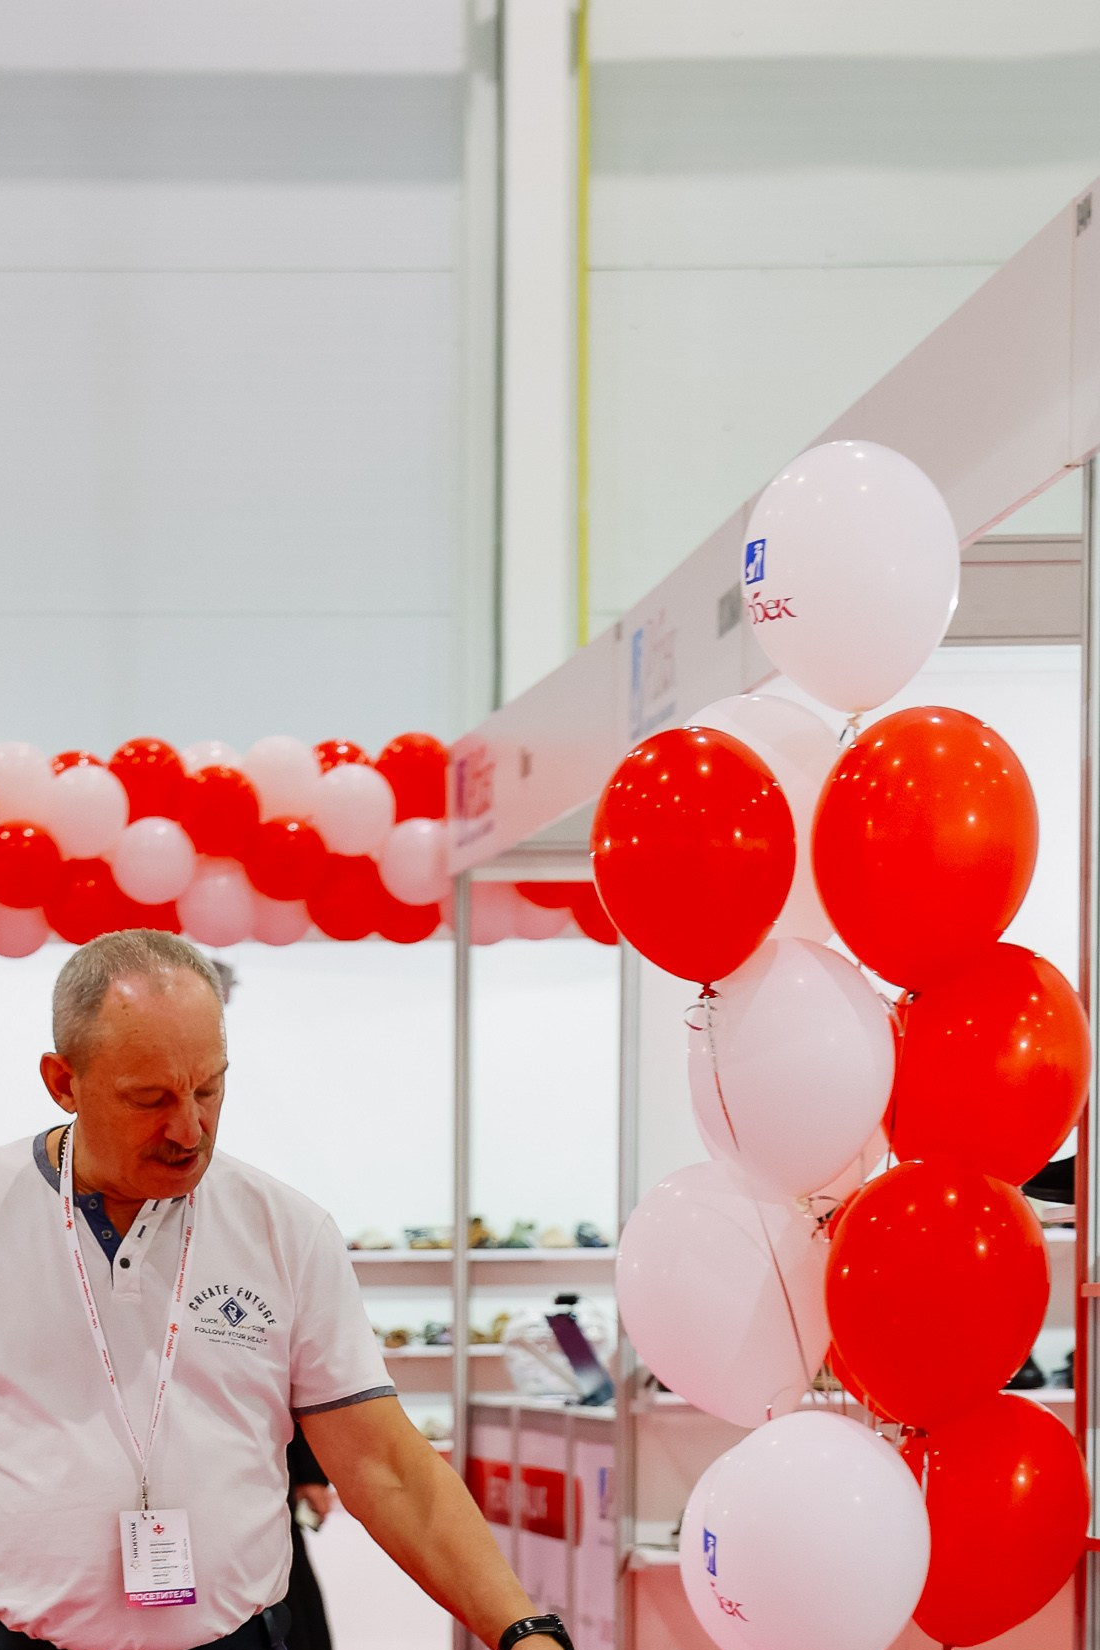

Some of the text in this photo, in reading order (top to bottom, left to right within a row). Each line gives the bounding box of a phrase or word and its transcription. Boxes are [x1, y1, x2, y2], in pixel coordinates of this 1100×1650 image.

[188, 1284, 277, 1326] CREATE FUTURE
[194, 1326, 226, 1336] FOLLOW
[228, 1330, 246, 1340] YOUR
[128, 1589, 194, 1602] ПОСЕТИТЕЛЬ
